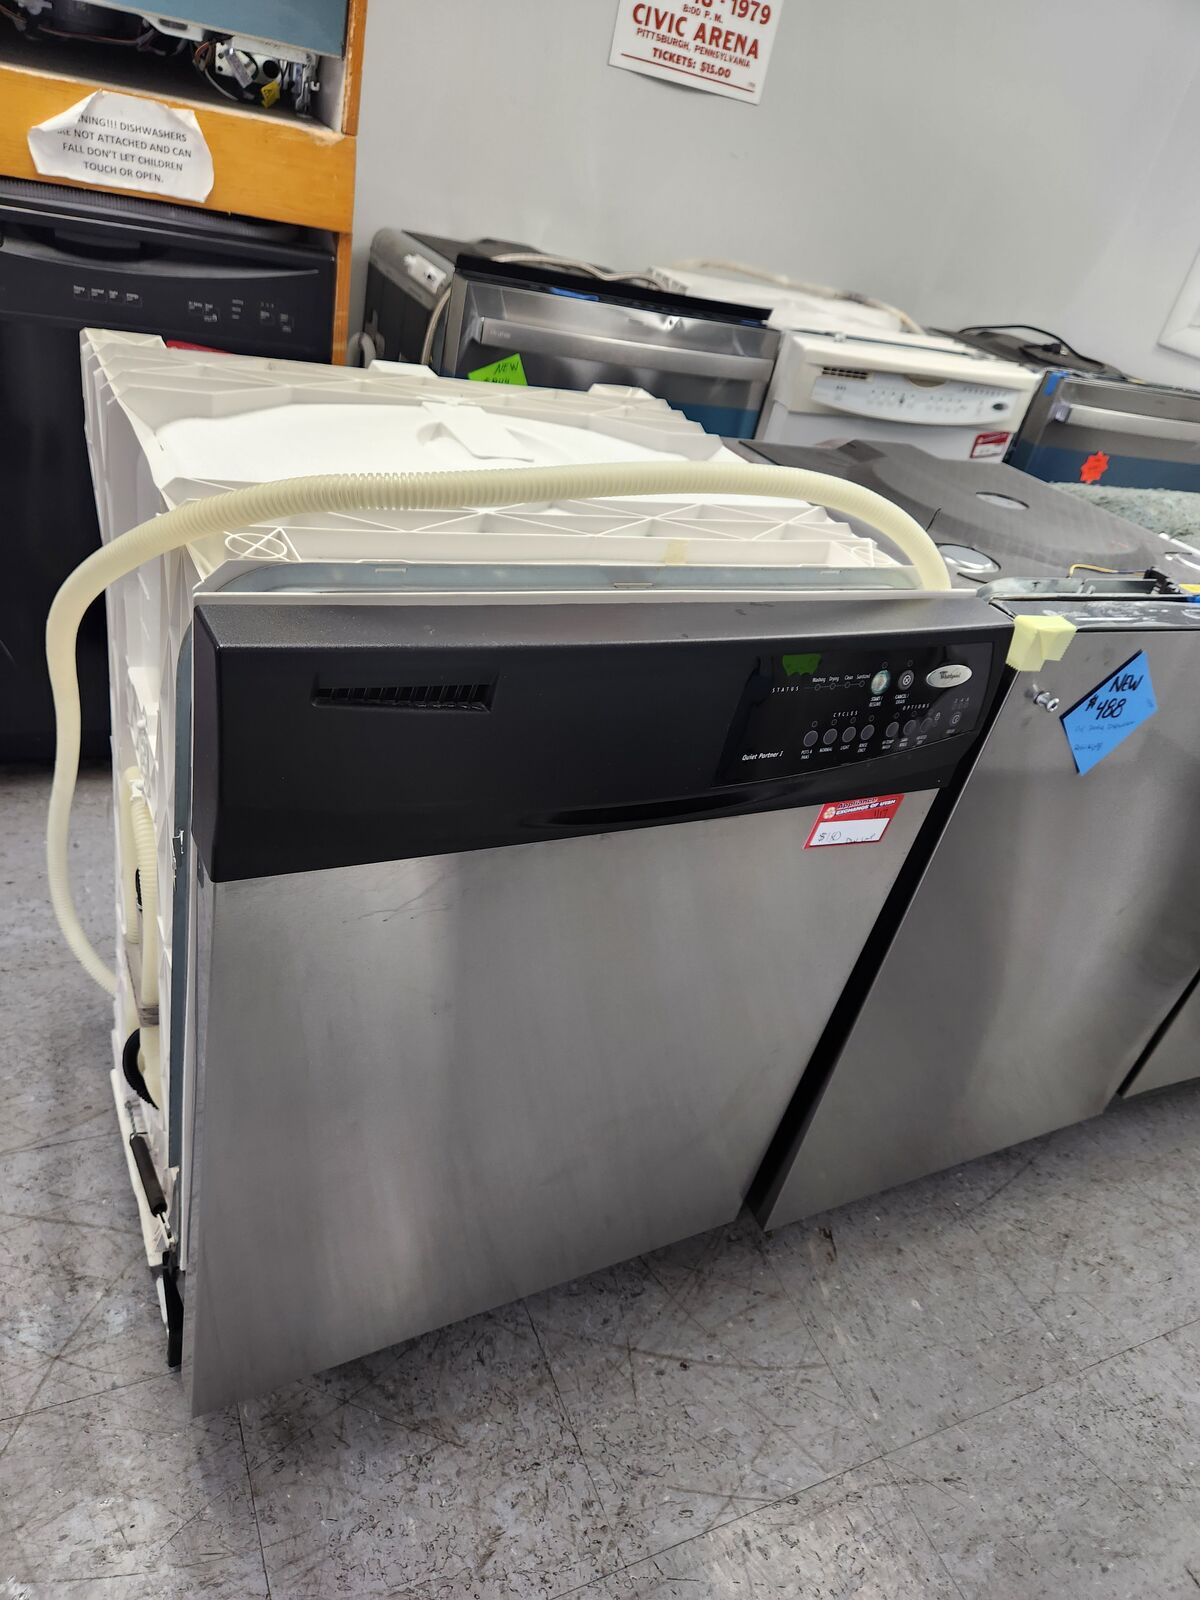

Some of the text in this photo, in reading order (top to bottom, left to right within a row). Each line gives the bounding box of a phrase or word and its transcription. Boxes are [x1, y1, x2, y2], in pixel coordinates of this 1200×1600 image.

[682, 4, 701, 17] 8:00
[731, 0, 771, 25] 1979
[632, 3, 760, 60] CIVIC ARENA
[652, 47, 731, 79] TICKETS: $15.00
[694, 45, 751, 68] PENNSYLVANIA
[77, 114, 187, 143] NING!!! DISHWASHERS
[74, 130, 95, 141] NOT
[97, 134, 148, 151] ATTACHED
[150, 144, 171, 154] AND
[172, 148, 192, 159] CAN
[62, 142, 184, 171] FALL DON'T LET CHILDREN
[84, 161, 164, 183] TOUCH OR OPEN.
[495, 362, 519, 375] NEW
[771, 686, 800, 695] STATUS
[1109, 673, 1144, 692] NEW
[833, 710, 858, 718] CYCLES
[902, 703, 930, 711] OPTIONS
[741, 753, 757, 761] Quiet
[758, 751, 779, 759] Partner
[836, 803, 870, 815] EXCHANGE
